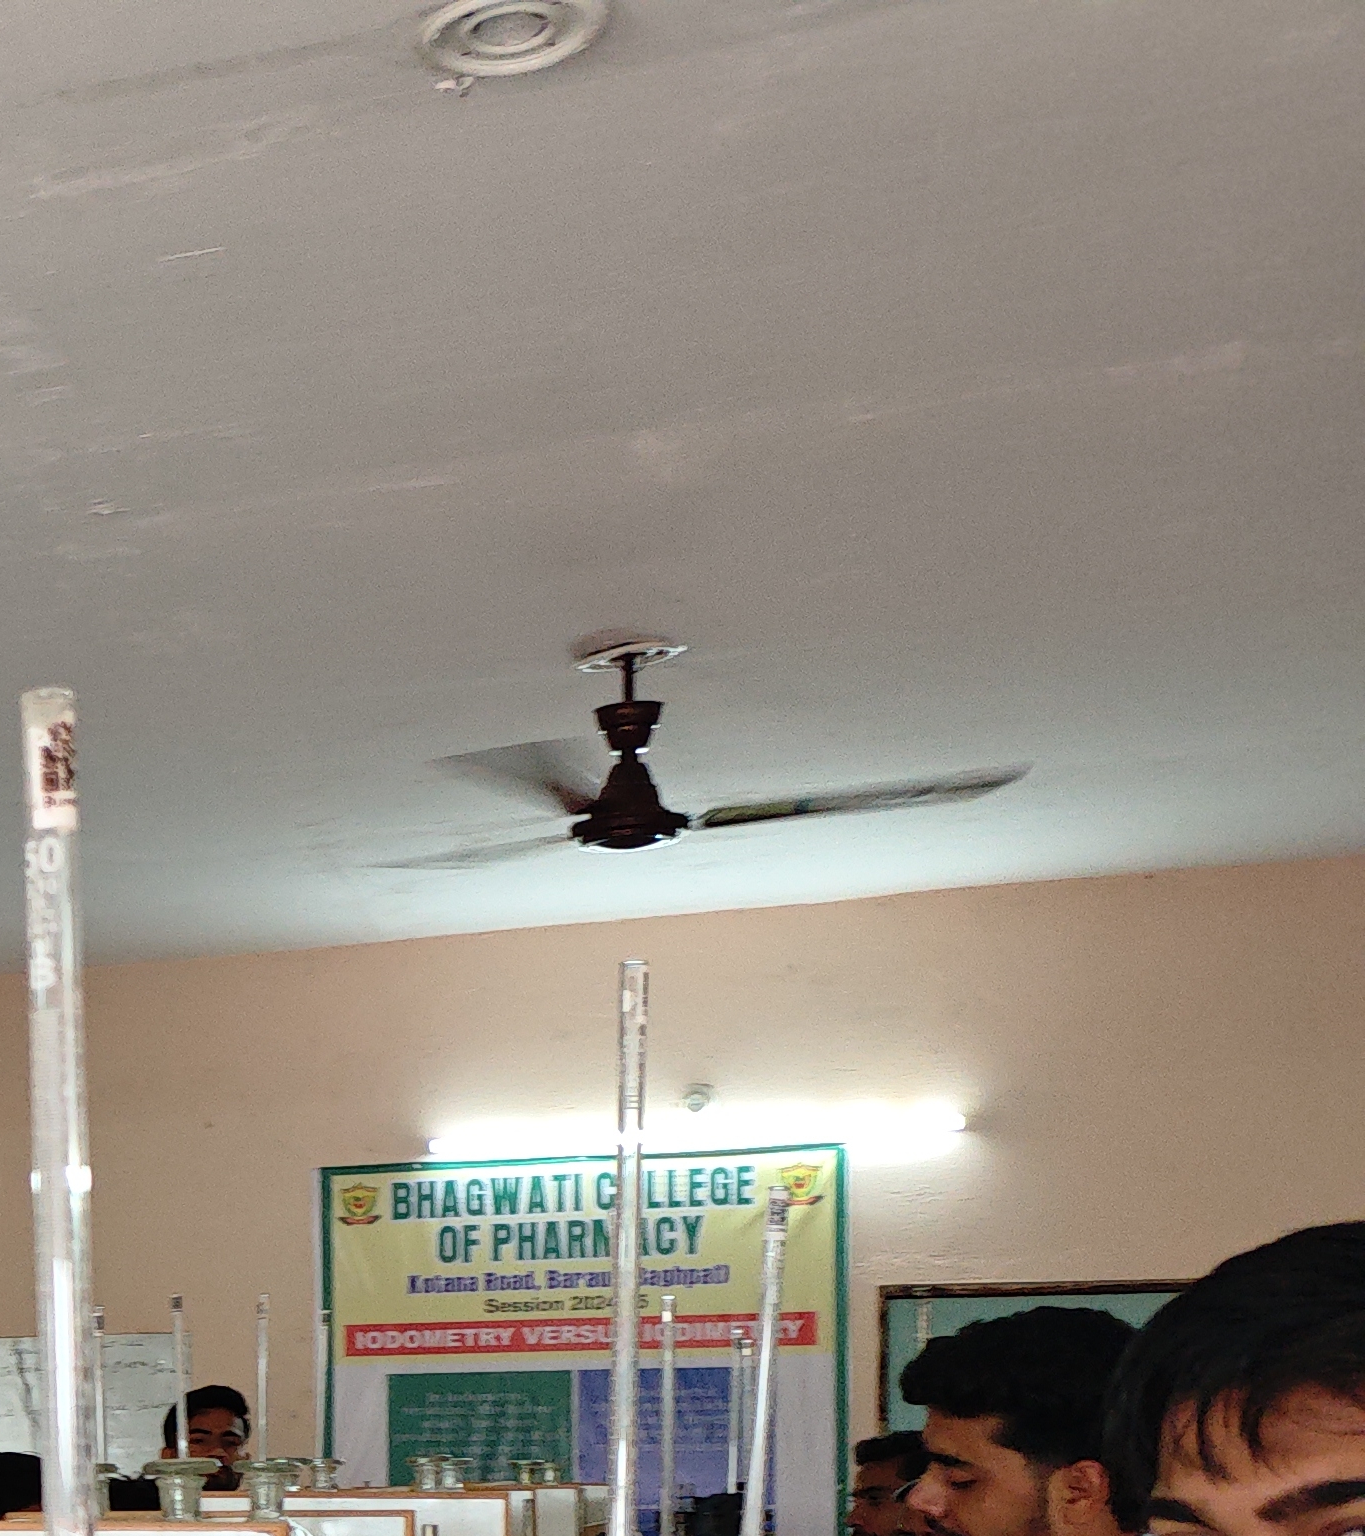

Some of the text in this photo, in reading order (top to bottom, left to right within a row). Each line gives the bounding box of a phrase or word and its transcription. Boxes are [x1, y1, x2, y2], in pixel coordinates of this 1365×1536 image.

[391, 1165, 756, 1221] BHAGWATI CLLEGE
[438, 1214, 705, 1264] OF PHARMCY
[544, 1269, 613, 1289] Barau
[483, 1297, 565, 1314] Session
[354, 1327, 518, 1350] IODOMETRY
[519, 1325, 614, 1345] VERSU
